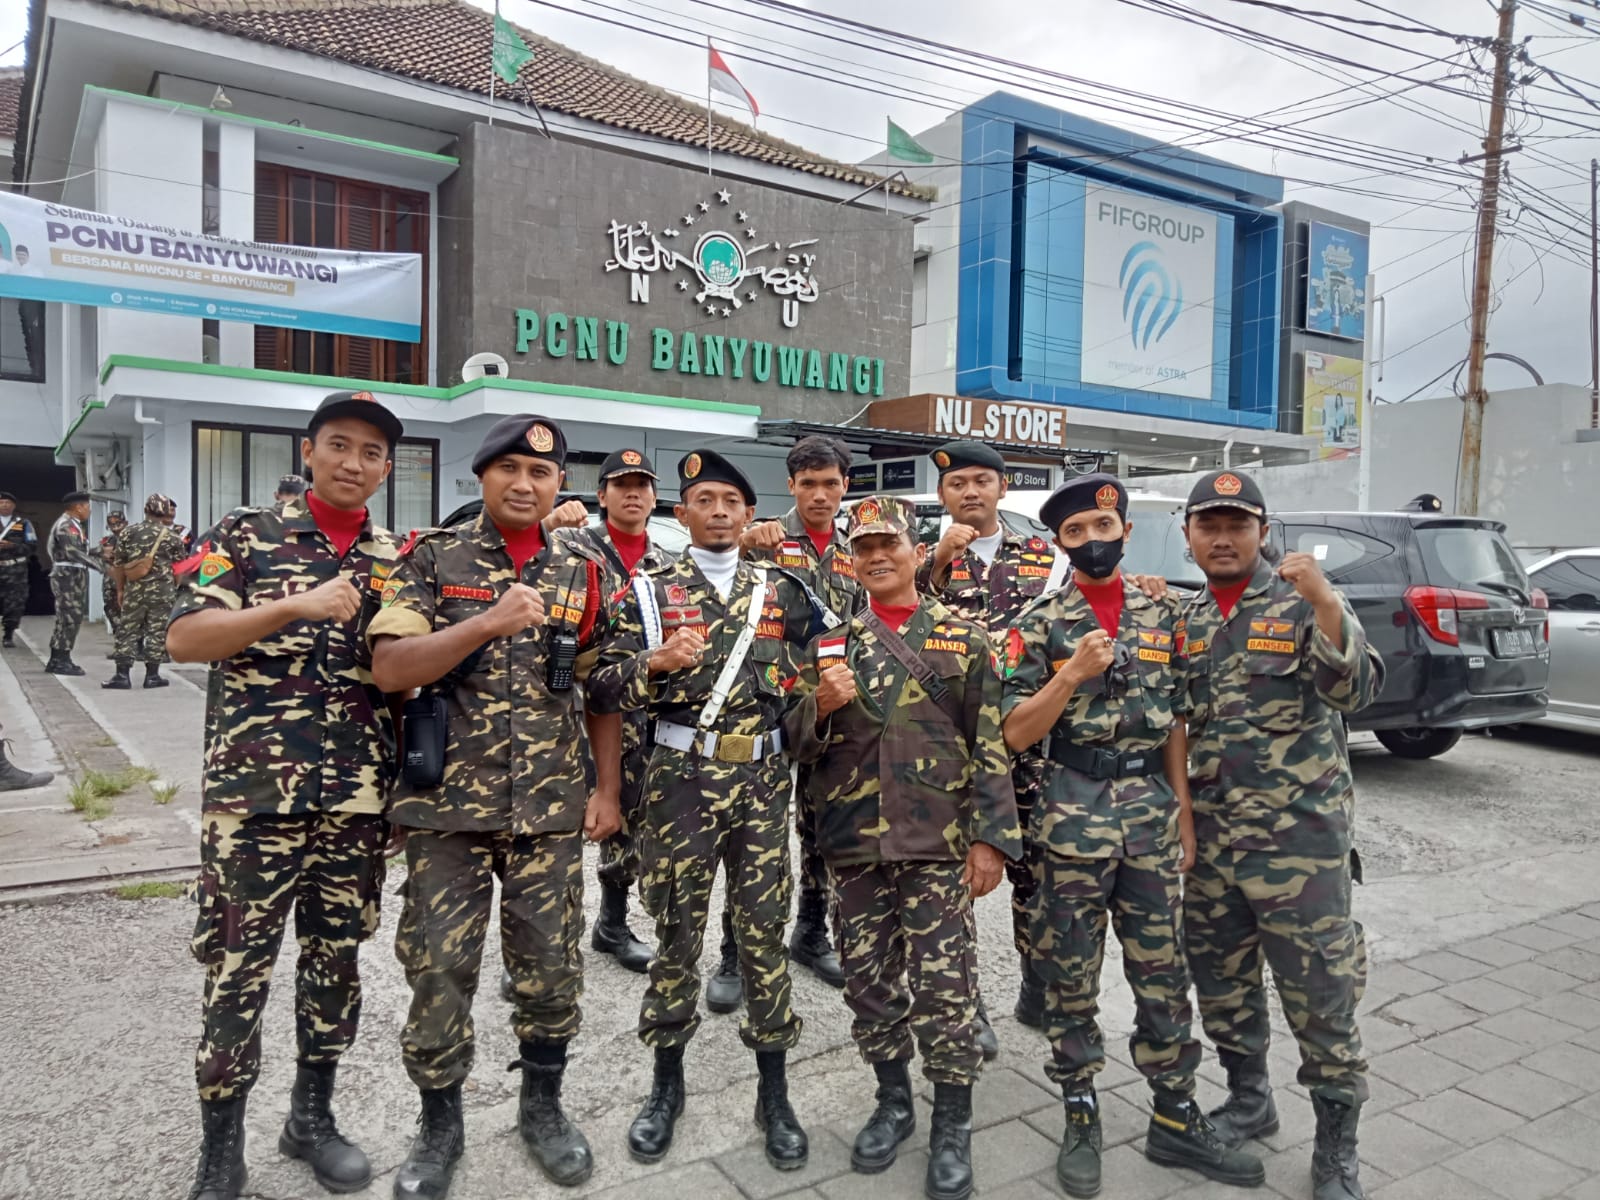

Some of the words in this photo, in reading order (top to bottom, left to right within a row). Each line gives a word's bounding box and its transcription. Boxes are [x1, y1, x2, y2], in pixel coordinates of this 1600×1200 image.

[1098, 201, 1205, 244] FIFGROUP
[46, 221, 145, 254] PCNU
[150, 236, 338, 283] BANYUWANGI
[61, 253, 133, 271] BERSAMA
[134, 263, 183, 279] MWCNU
[186, 270, 202, 280] SE
[212, 273, 288, 293] BANYUWANGI
[631, 274, 649, 303] N
[783, 300, 799, 328] U
[515, 308, 629, 366] PCNU
[652, 328, 884, 396] BANYUWANGI
[1157, 367, 1187, 381] ASTRA
[1024, 474, 1046, 486] Store
[924, 638, 968, 655] BANSER
[1250, 640, 1291, 652] BANSER
